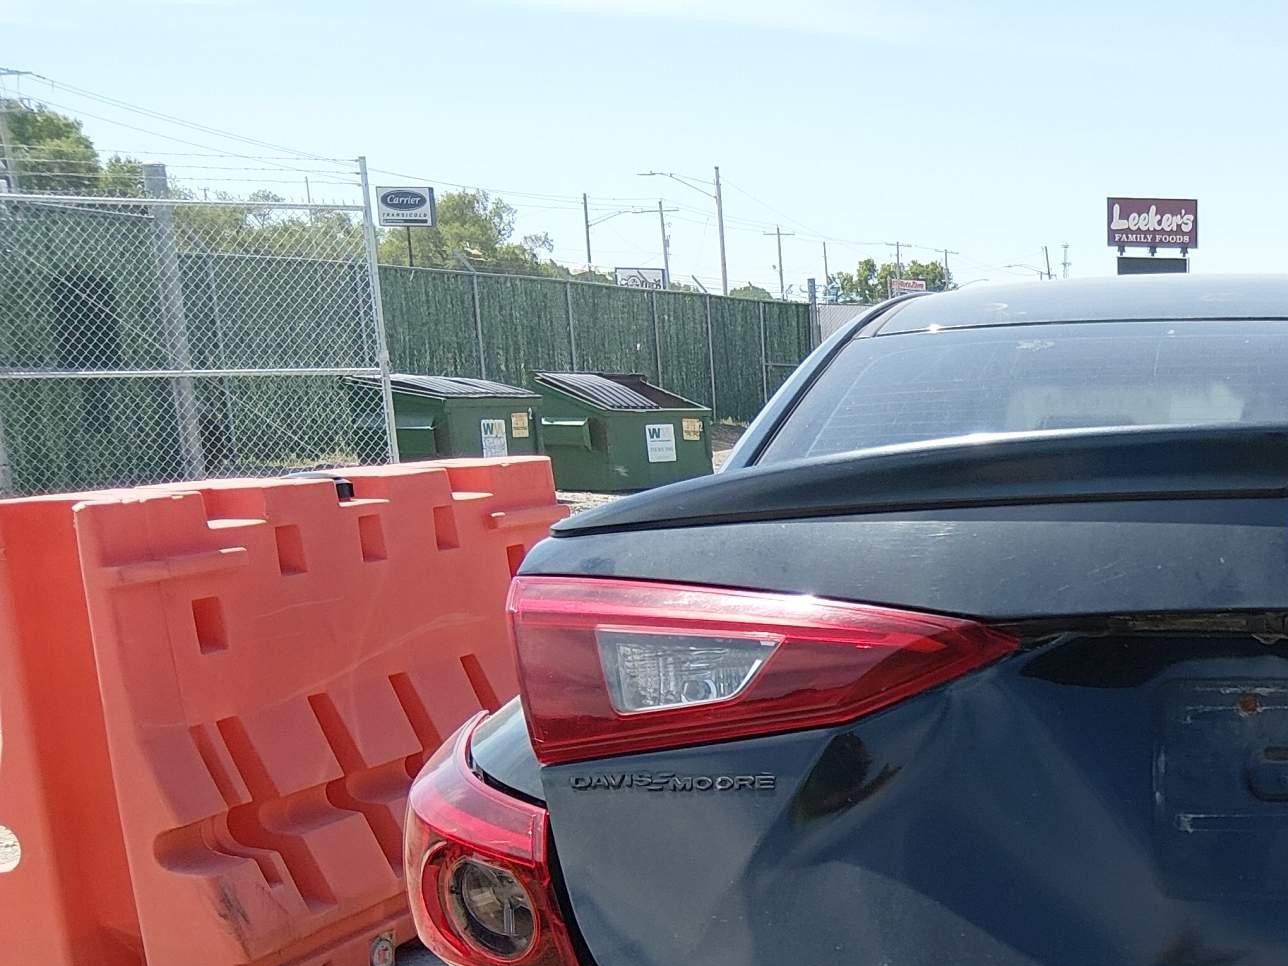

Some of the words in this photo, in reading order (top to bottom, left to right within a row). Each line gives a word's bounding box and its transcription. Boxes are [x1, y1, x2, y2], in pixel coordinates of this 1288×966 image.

[386, 195, 421, 205] Carrier
[1110, 203, 1194, 232] Leeker's
[1114, 234, 1153, 242] FAMILY
[1156, 235, 1190, 243] FOODS
